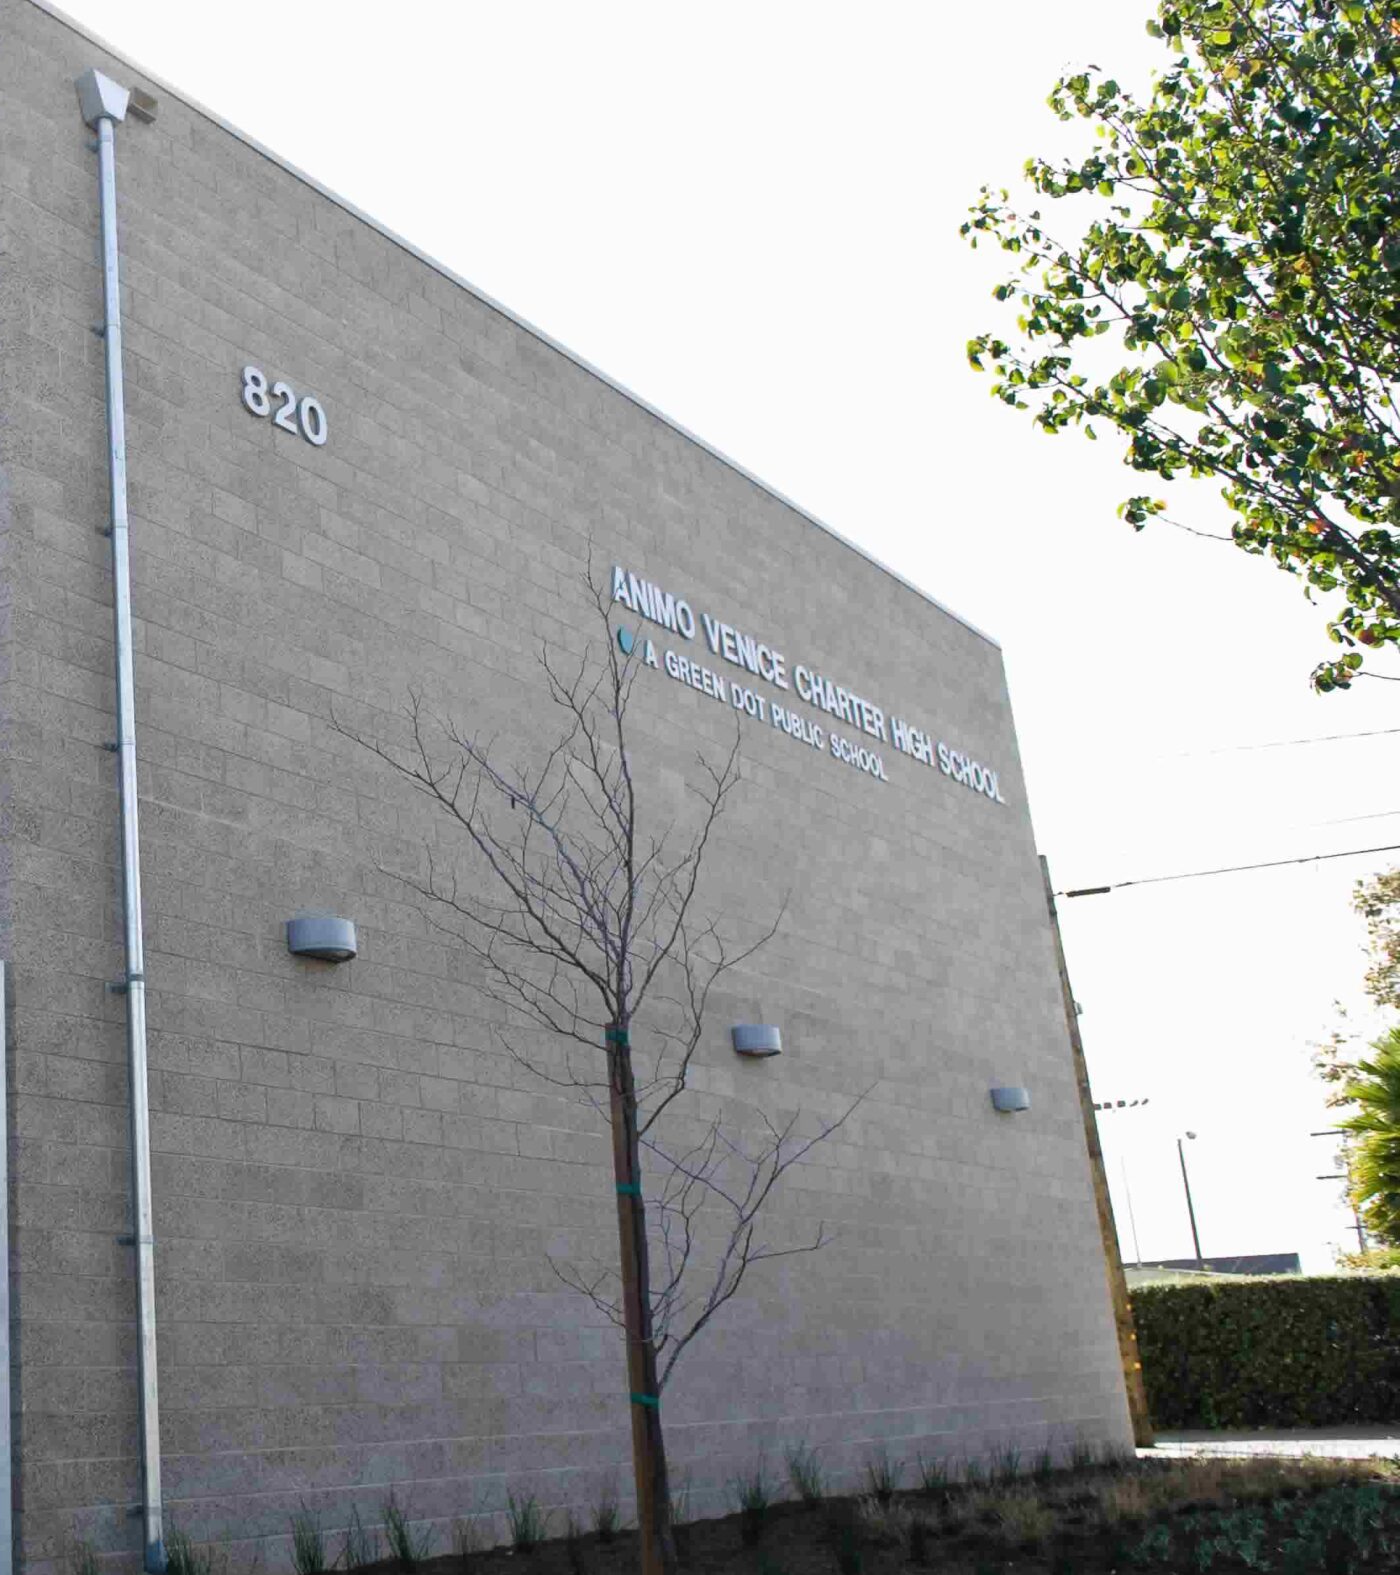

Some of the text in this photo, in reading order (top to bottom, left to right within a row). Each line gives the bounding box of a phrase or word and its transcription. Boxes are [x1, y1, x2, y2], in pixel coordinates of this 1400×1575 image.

[241, 365, 328, 446] 820
[612, 565, 1006, 804] ANIMO VENICE CHARTER HIGH SCHOOL
[644, 639, 889, 782] A GREEN DOT PUBLIC SCHOOL
